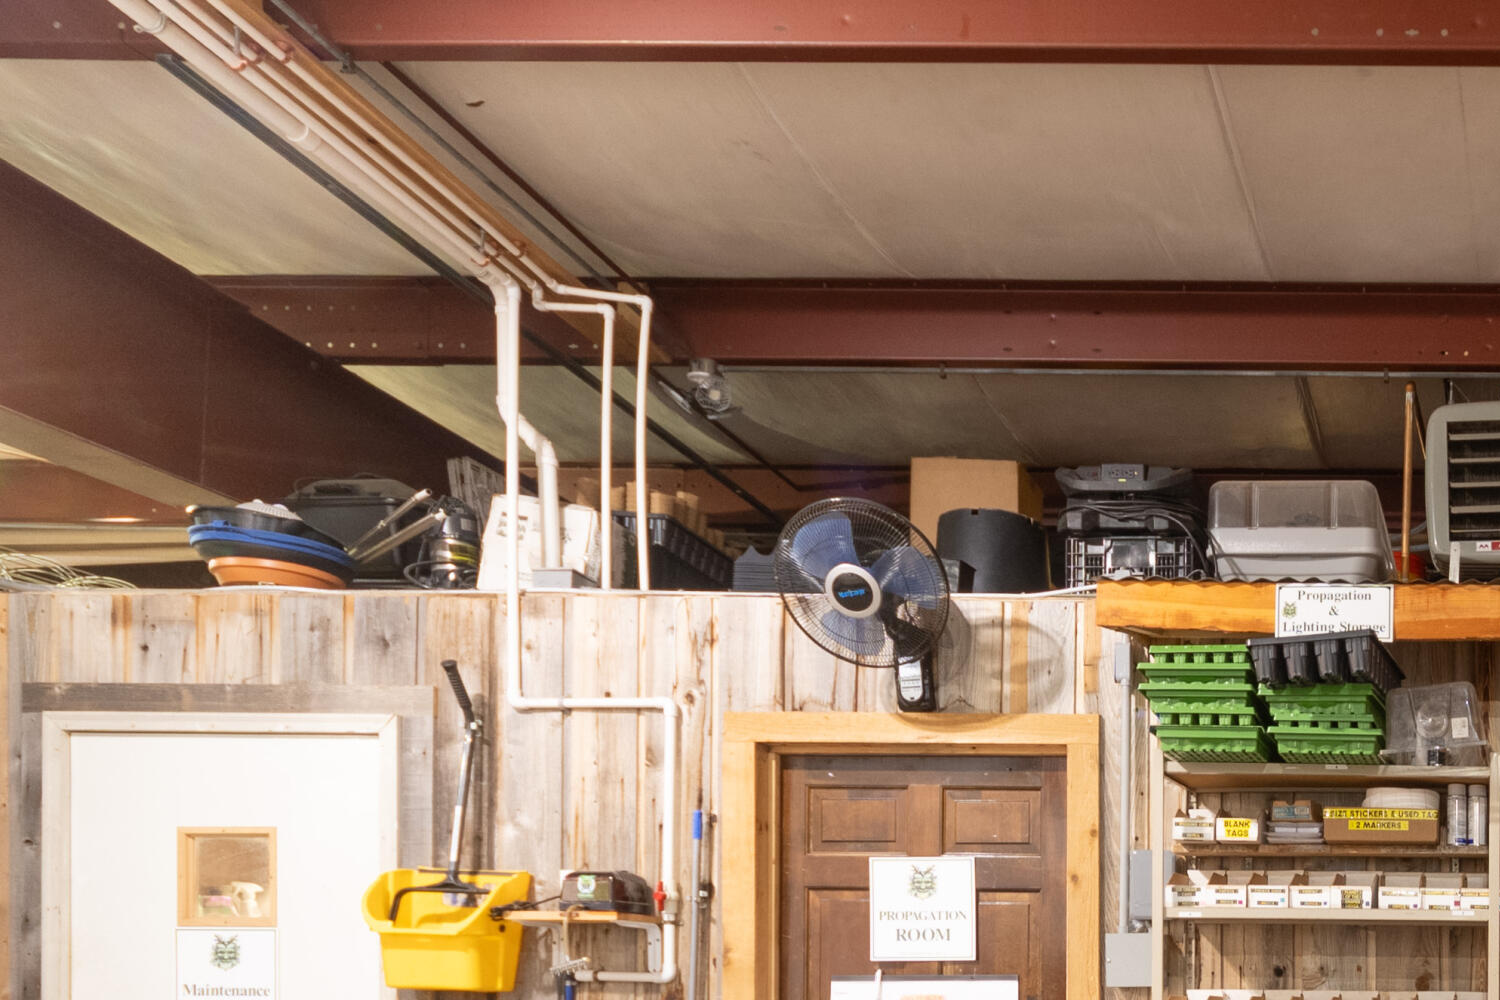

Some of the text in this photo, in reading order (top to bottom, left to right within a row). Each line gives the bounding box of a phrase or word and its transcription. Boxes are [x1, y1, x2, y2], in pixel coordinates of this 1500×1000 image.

[1298, 590, 1372, 603] Propagation
[1329, 605, 1338, 616] &
[1283, 621, 1386, 633] Lighting Storage
[1224, 820, 1250, 828] BLANK
[1226, 829, 1249, 837] TAGS
[879, 910, 968, 921] PROPAGATION
[896, 928, 951, 941] ROOM
[183, 983, 271, 997] Maintenance
